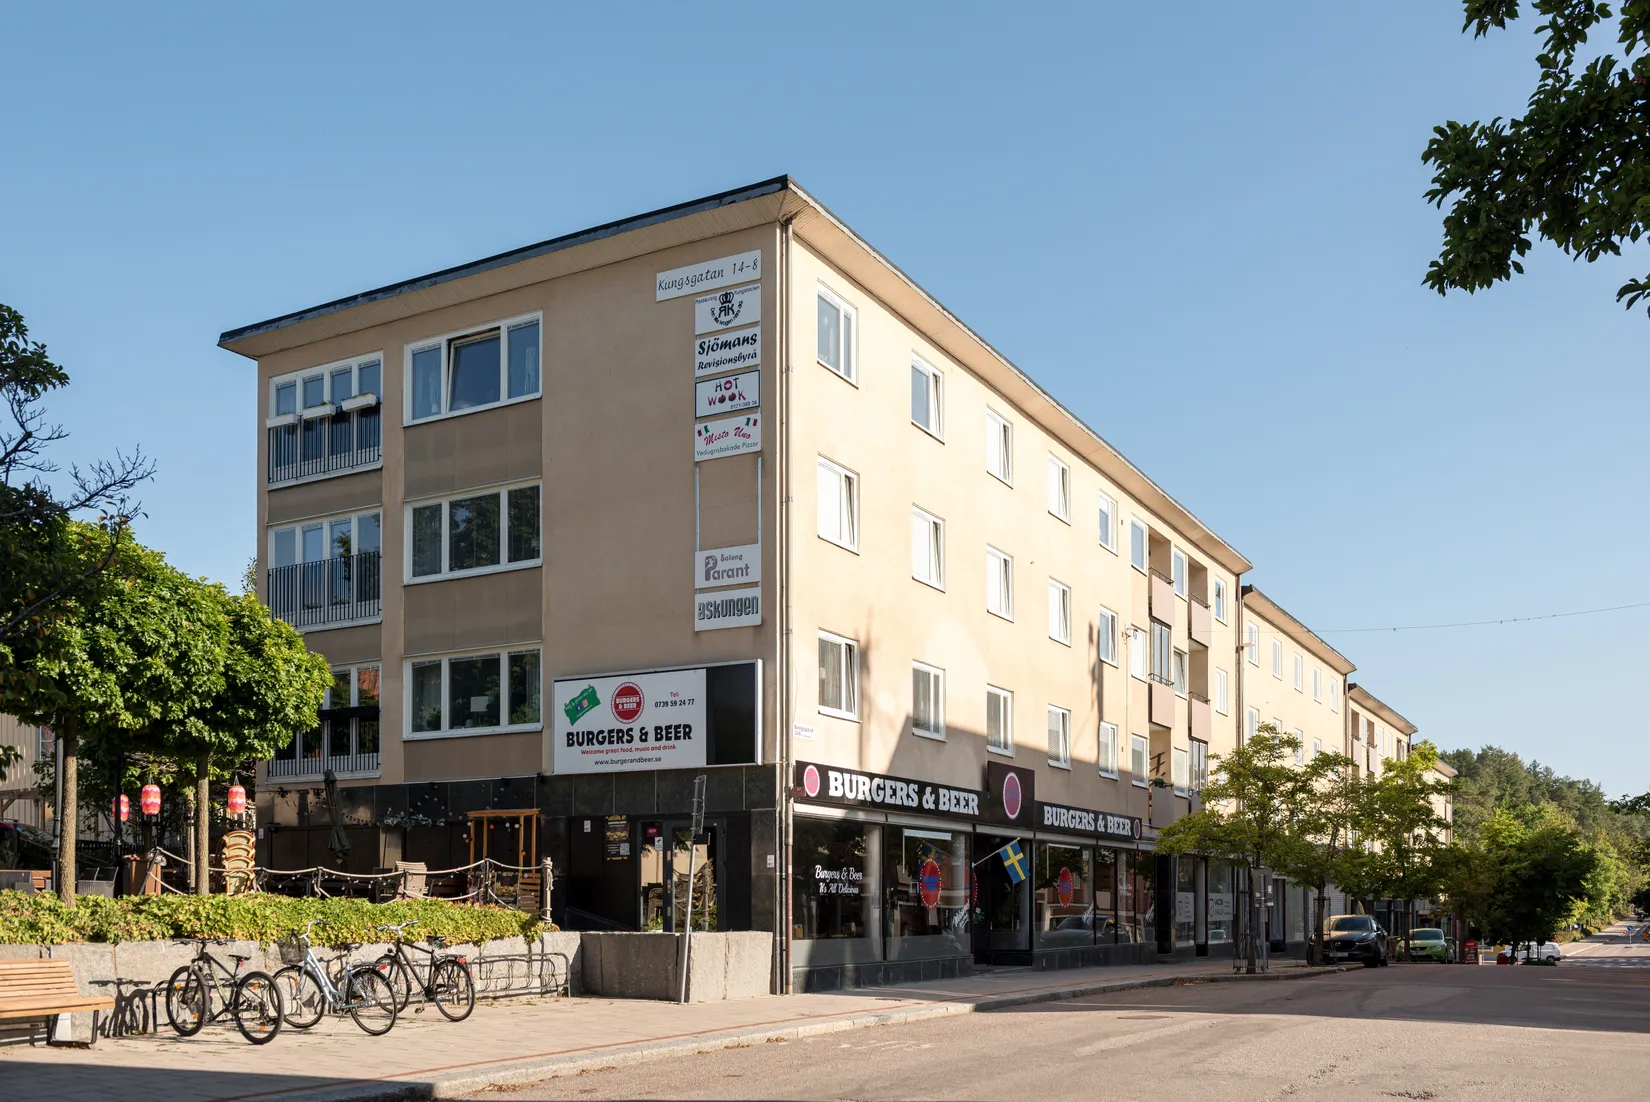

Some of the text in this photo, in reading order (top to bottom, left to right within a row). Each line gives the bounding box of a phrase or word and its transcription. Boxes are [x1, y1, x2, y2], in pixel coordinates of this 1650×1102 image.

[658, 258, 758, 291] Kungsgatan 14-8
[698, 333, 757, 356] Sjömans
[698, 349, 757, 370] Revisionsbyrå
[715, 377, 739, 392] HOT
[734, 426, 751, 439] Uno
[705, 555, 750, 581] Parant
[720, 554, 743, 562] Salong
[698, 595, 759, 620] askungen
[654, 700, 669, 708] 0739
[566, 724, 692, 747] BURGERS & BEER
[594, 756, 662, 765] www.burgerandbeer.se
[828, 770, 979, 816] BURGERS & BEER
[1043, 805, 1132, 836] BURGERS & BEER
[815, 864, 863, 882] Burgers & Beer
